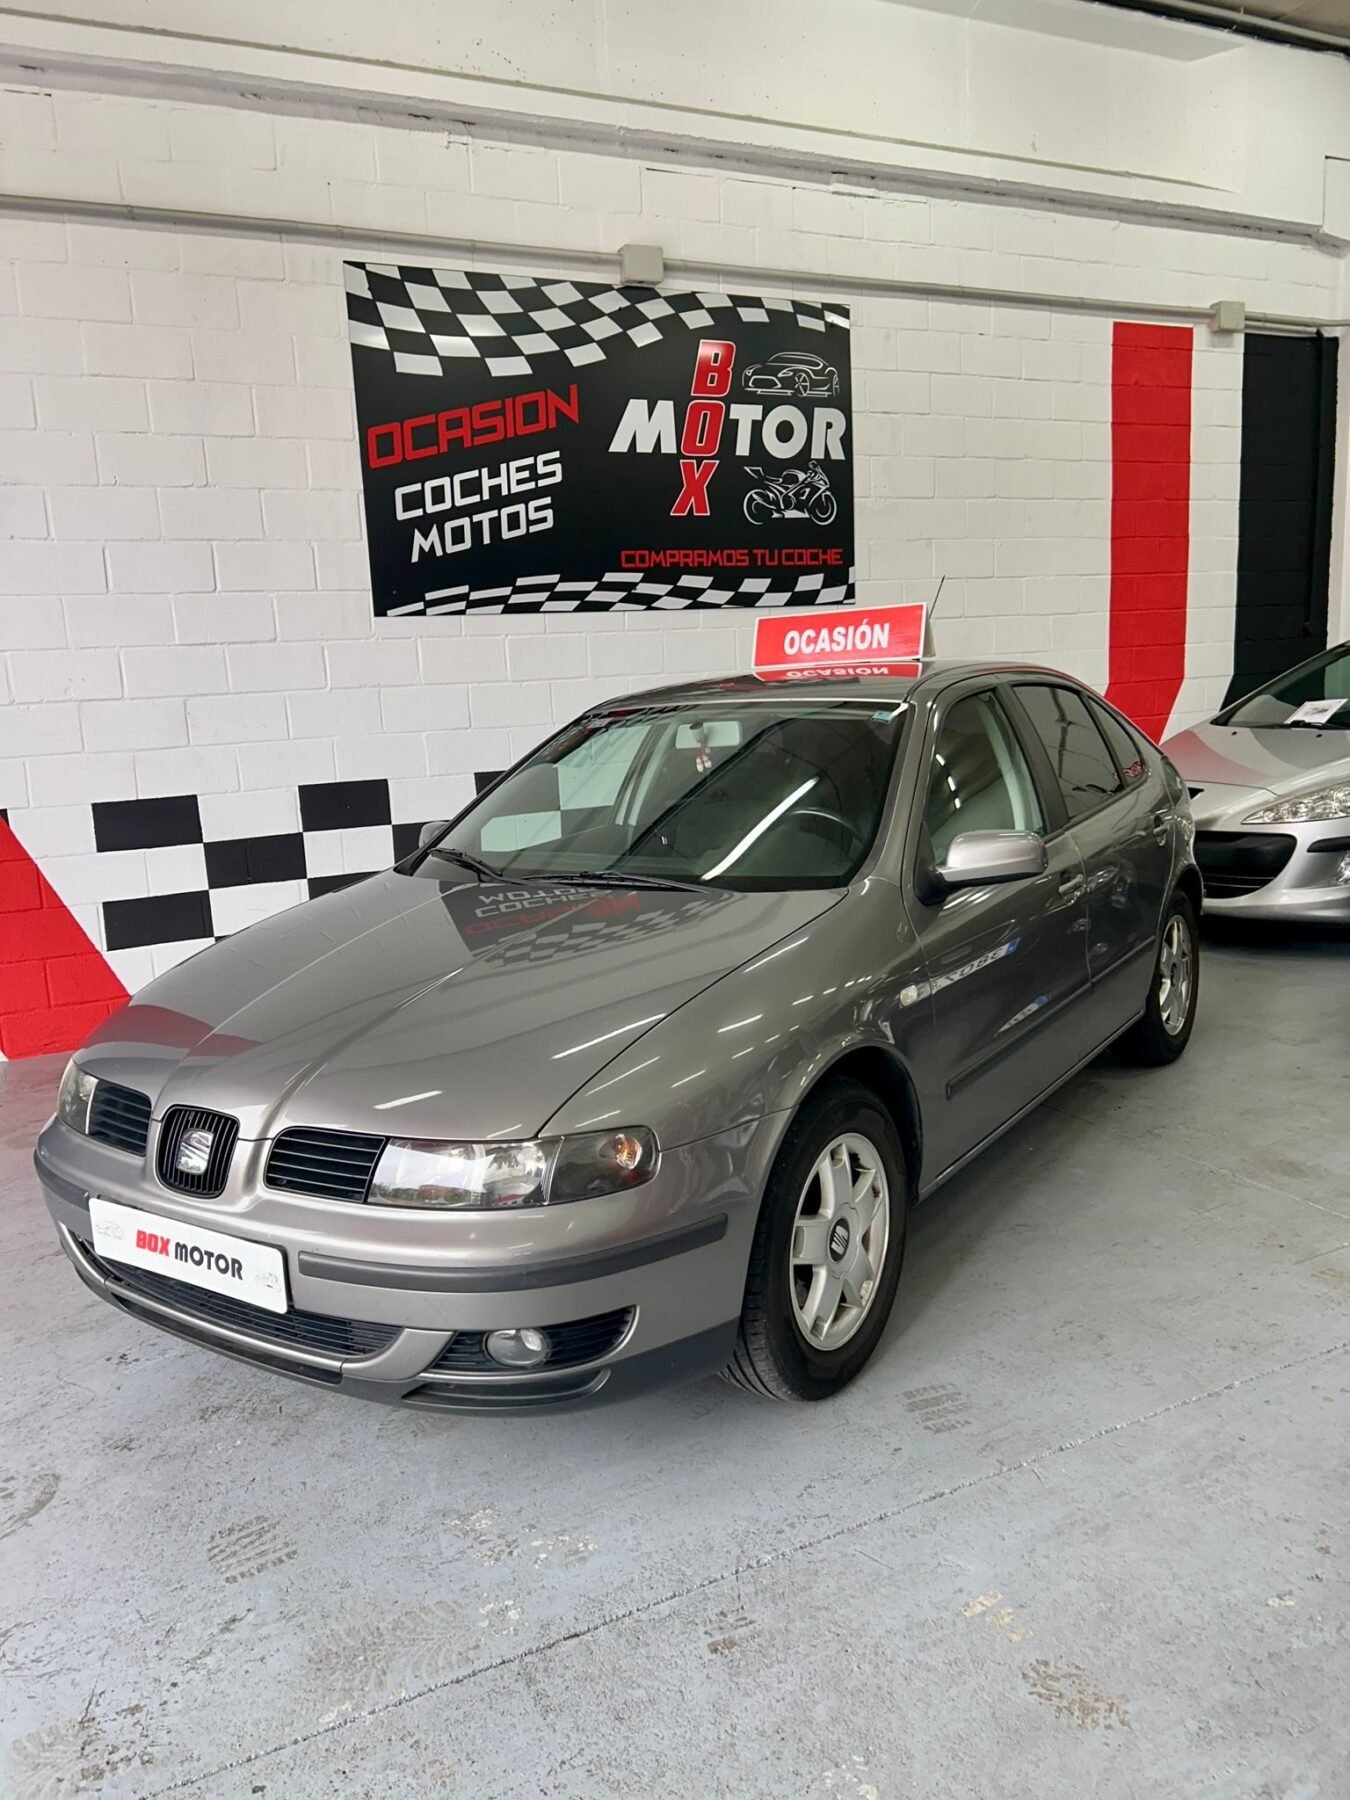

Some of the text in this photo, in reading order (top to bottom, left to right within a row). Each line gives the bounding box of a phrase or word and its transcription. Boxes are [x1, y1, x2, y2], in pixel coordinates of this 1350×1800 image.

[367, 383, 580, 469] OCASION
[608, 398, 847, 460] MOTOR
[670, 339, 736, 516] BOX
[395, 450, 563, 521] COCHES
[411, 496, 554, 563] MOTOS
[620, 548, 843, 568] COMPRAMOS TU COCHE
[783, 618, 890, 656] OCASIÓN
[136, 1230, 243, 1280] BOX MOTOR
